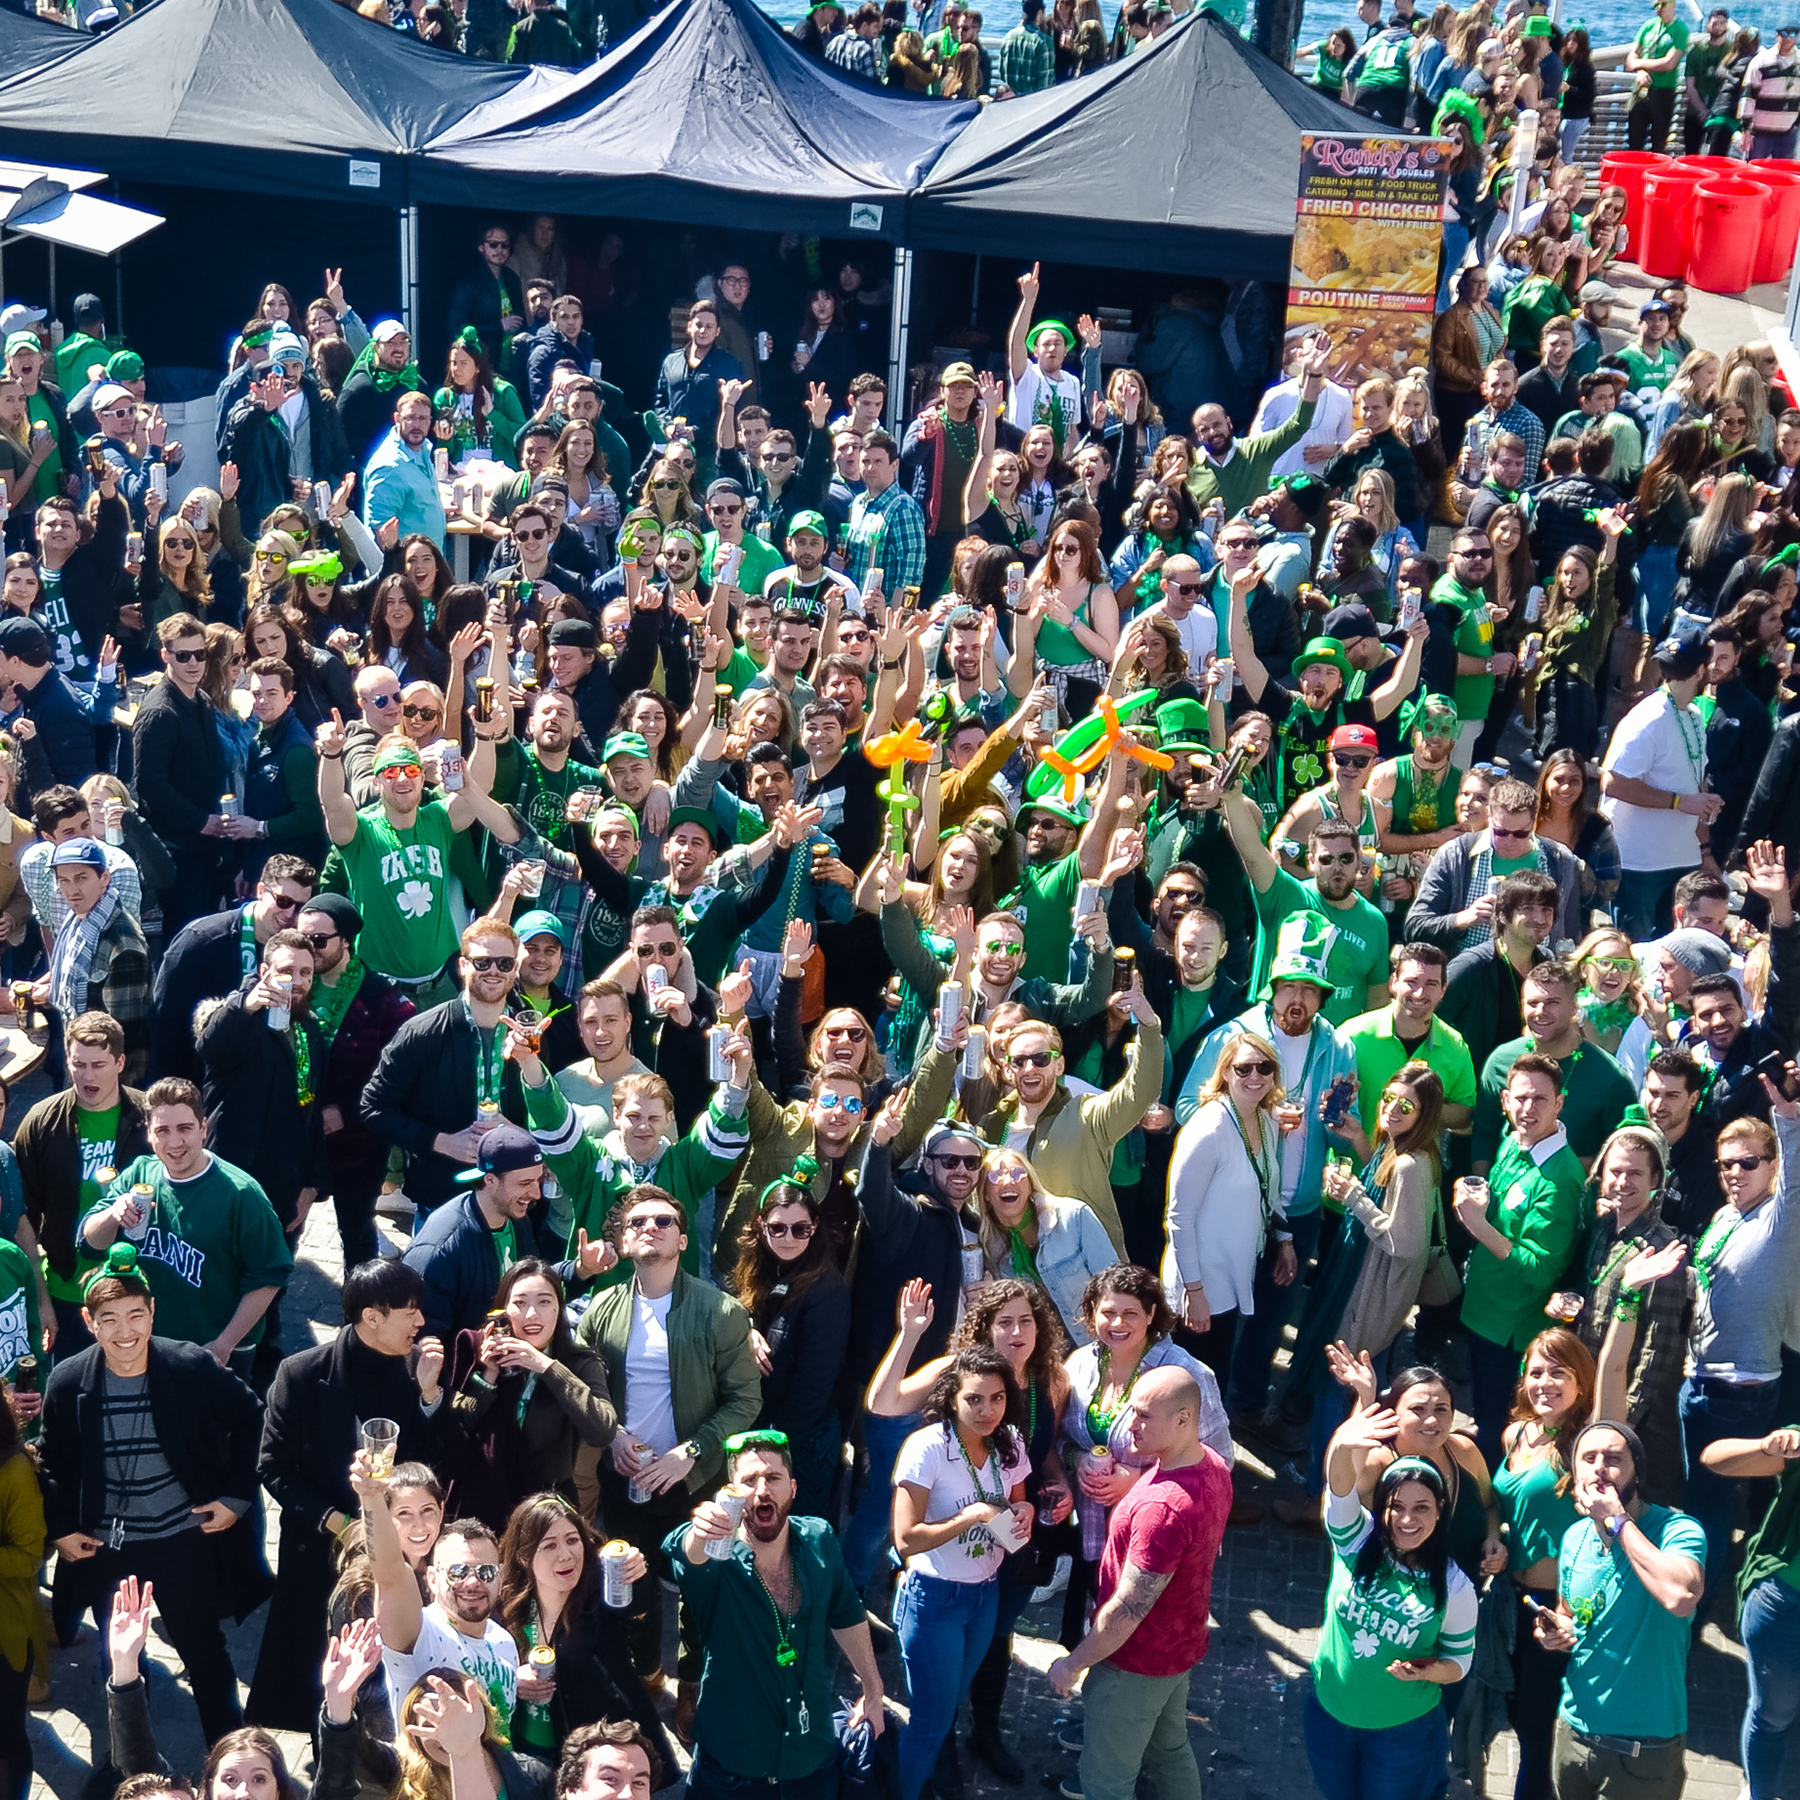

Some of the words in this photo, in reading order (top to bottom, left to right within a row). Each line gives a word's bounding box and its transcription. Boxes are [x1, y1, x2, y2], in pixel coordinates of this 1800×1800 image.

[1313, 139, 1420, 179] Randy's
[1357, 167, 1378, 175] ROTI
[1397, 168, 1435, 177] DOUBLES
[1309, 176, 1338, 185] FRESH
[1340, 178, 1374, 187] ON-SITE
[1381, 180, 1406, 189] FOOD
[1408, 181, 1438, 190] TRUCK
[1305, 187, 1348, 196] CATERING
[1355, 190, 1387, 199] DINE-IN
[1397, 192, 1419, 200] TAKE
[1422, 193, 1440, 201] OUT
[1302, 199, 1354, 215] FRIED
[1359, 202, 1438, 219] CHICKEN
[1377, 220, 1406, 228] WITH
[1407, 221, 1436, 230] FRIES
[1298, 290, 1380, 308] POUTINE
[1382, 295, 1428, 304] VEGETARIAN
[1344, 929, 1367, 951] LIVER
[1335, 1593, 1420, 1649] CHARM
